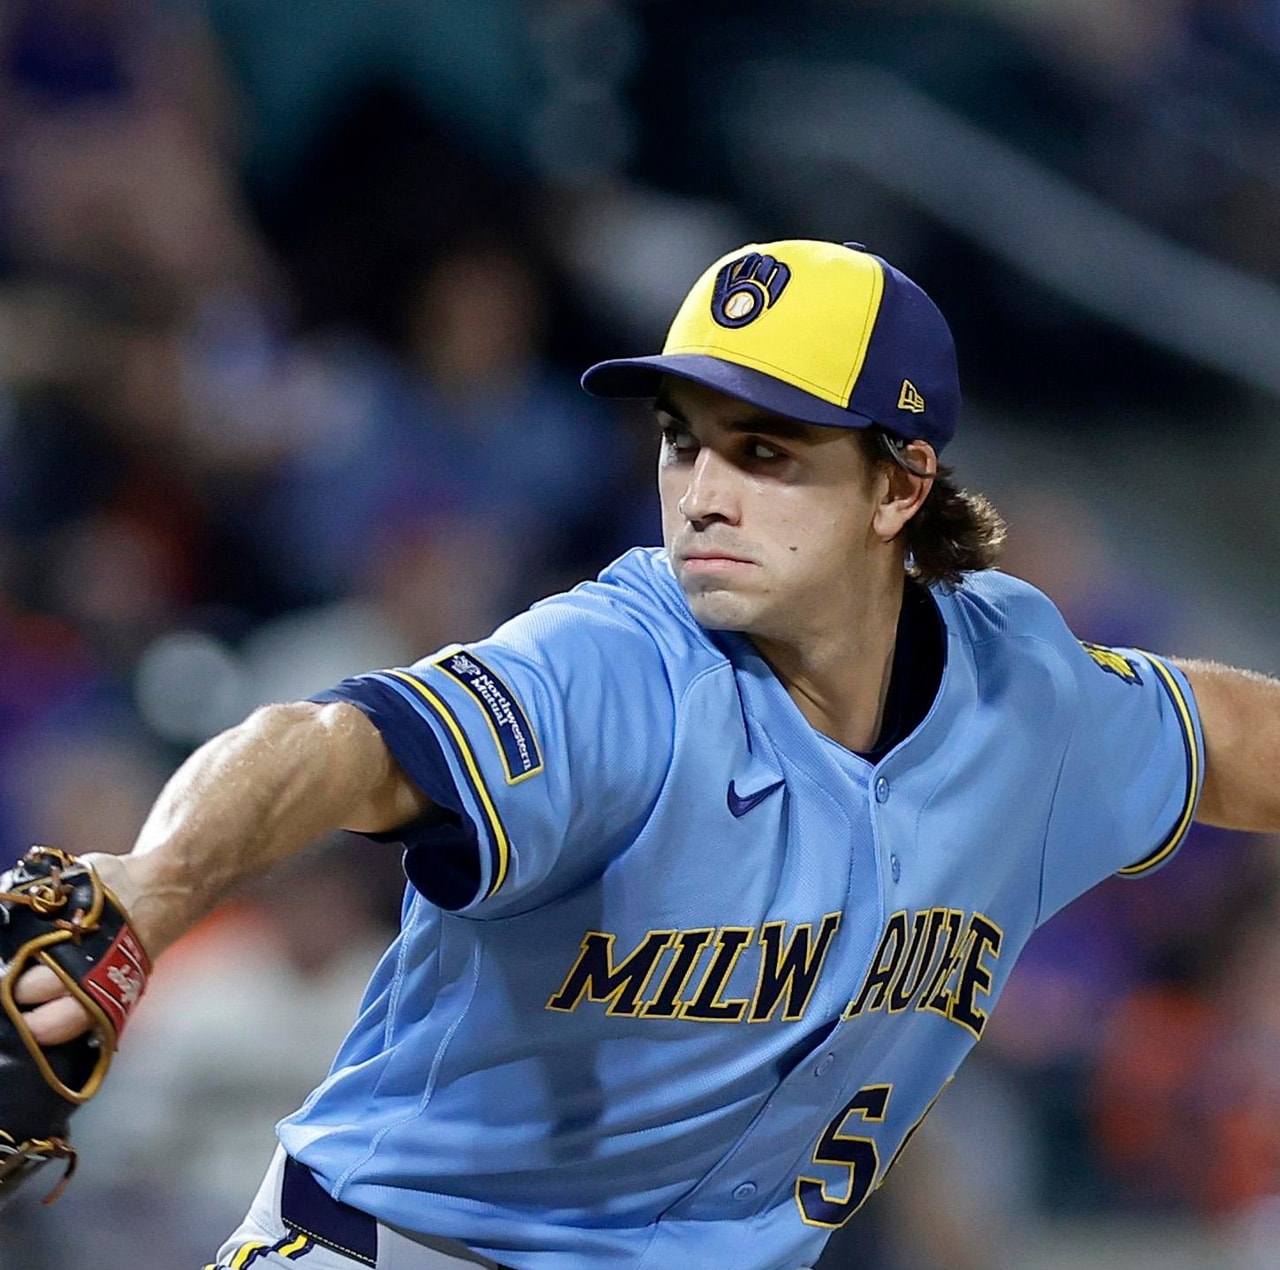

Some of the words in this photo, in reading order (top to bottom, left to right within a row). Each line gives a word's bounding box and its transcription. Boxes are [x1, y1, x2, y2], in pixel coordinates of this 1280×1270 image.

[470, 678, 509, 726] Mutual
[479, 674, 533, 771] Northwestern
[794, 1077, 955, 1228] 5
